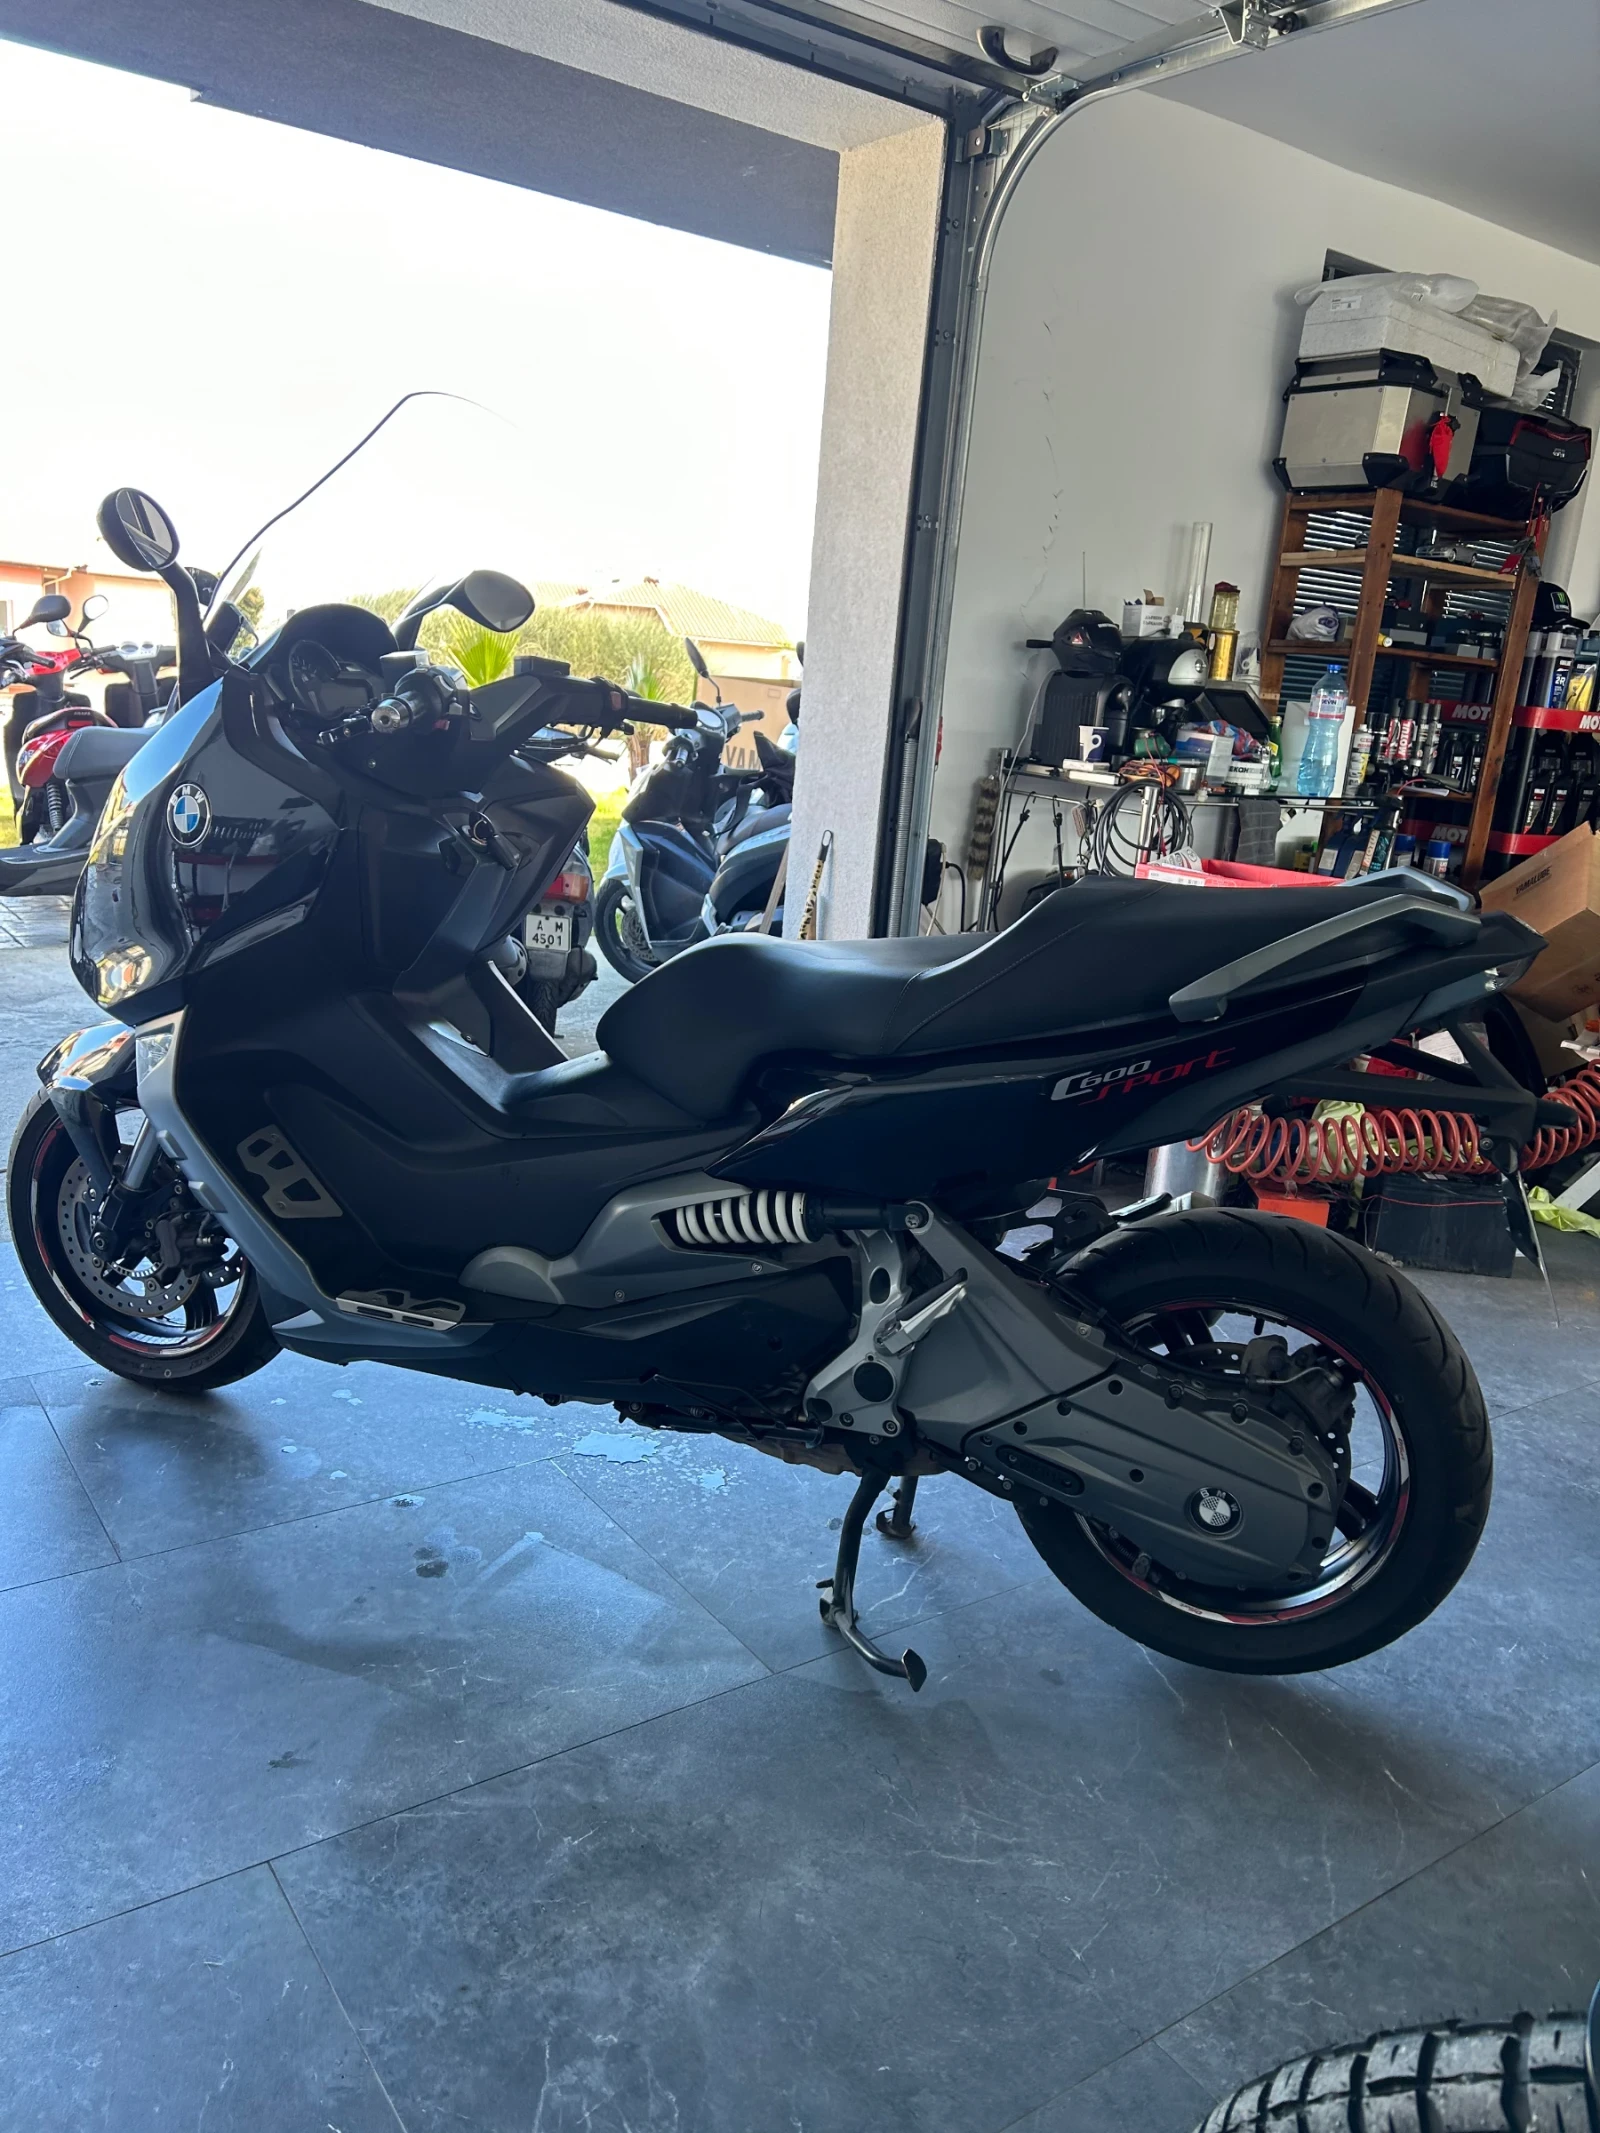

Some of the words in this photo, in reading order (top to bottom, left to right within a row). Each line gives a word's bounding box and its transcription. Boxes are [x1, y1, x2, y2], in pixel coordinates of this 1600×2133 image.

[1451, 703, 1493, 721] MOT
[1578, 714, 1600, 730] MO
[1398, 719, 1412, 756] MOTUL
[725, 744, 762, 770] YAM
[170, 785, 206, 807] BMW
[1431, 825, 1469, 844] MOT
[536, 919, 544, 932] A
[554, 921, 564, 933] M
[531, 932, 562, 947] 4501
[1200, 1489, 1239, 1512] BMW
